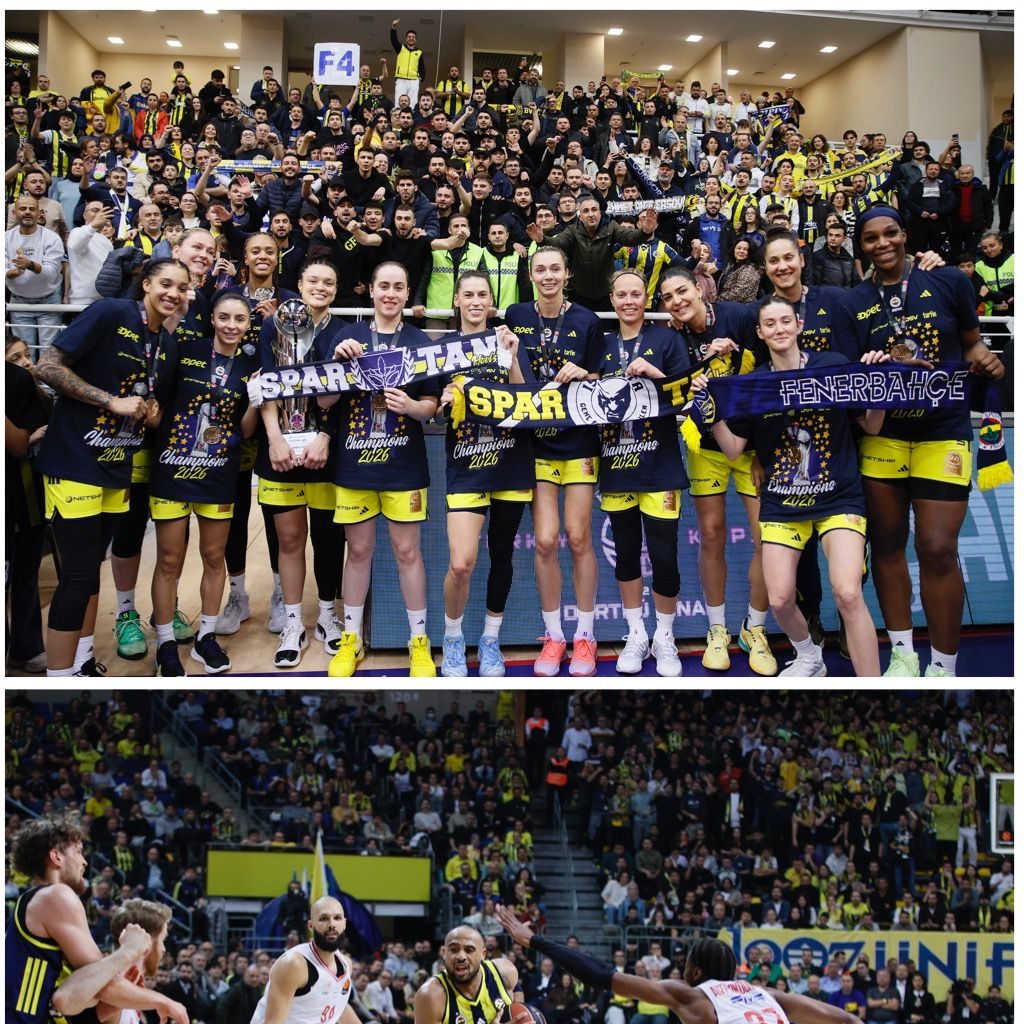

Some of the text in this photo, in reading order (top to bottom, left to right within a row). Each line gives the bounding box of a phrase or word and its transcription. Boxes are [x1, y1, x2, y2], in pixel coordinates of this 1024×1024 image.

[318, 50, 355, 77] F4
[856, 303, 881, 321] opet
[117, 326, 140, 343] opet
[513, 326, 535, 335] opet
[180, 357, 208, 369] opet
[261, 335, 497, 398] SPAR TAN
[780, 370, 969, 407] FENERBAHÇE
[468, 386, 566, 420] SPAR
[84, 430, 144, 450] Champions
[345, 434, 409, 454] Champions
[453, 437, 515, 459] Champions
[97, 448, 125, 462] 2026
[159, 450, 228, 471] Champions
[358, 448, 390, 463] 2026
[469, 451, 499, 469] 2026
[611, 453, 641, 469] 2026
[174, 466, 209, 479] 2026
[767, 480, 836, 497] Champions
[783, 494, 817, 507] 2026
